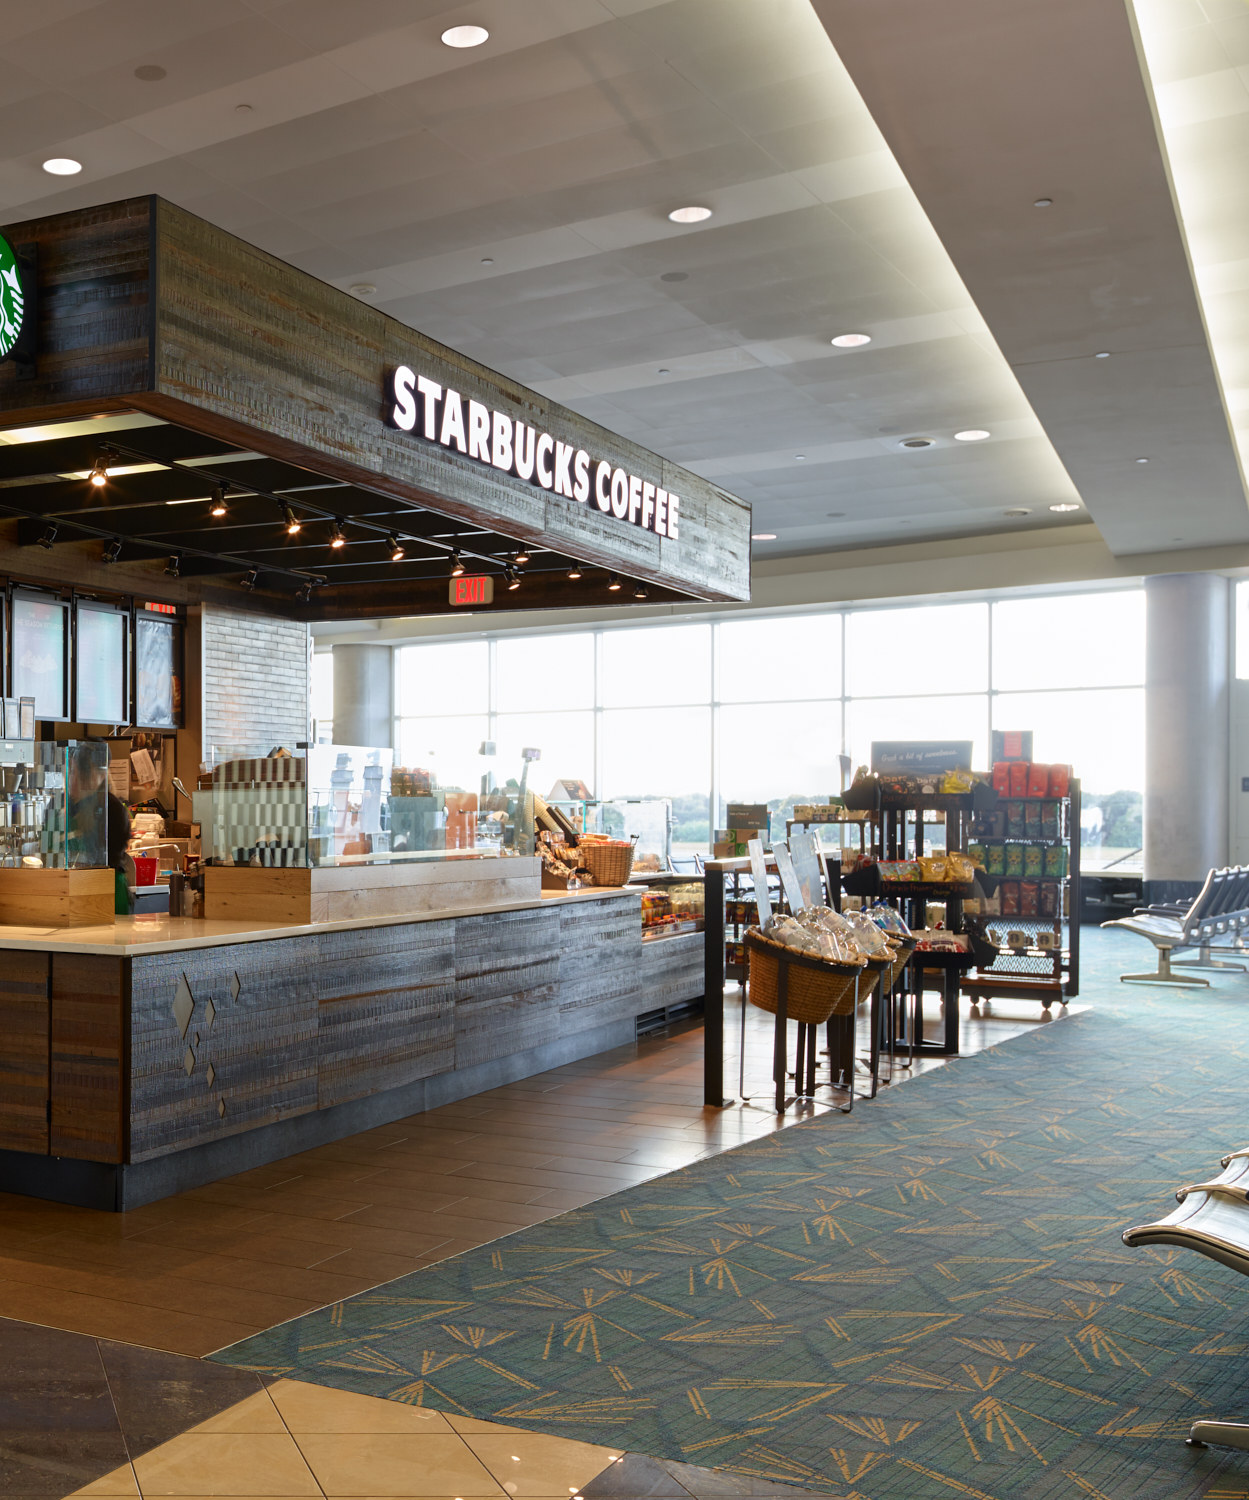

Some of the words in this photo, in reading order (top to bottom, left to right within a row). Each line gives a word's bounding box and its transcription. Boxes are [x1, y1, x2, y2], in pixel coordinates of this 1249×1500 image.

[393, 365, 590, 502] STARBUCKS
[596, 461, 679, 540] COFFEE
[455, 577, 487, 603] EXIT
